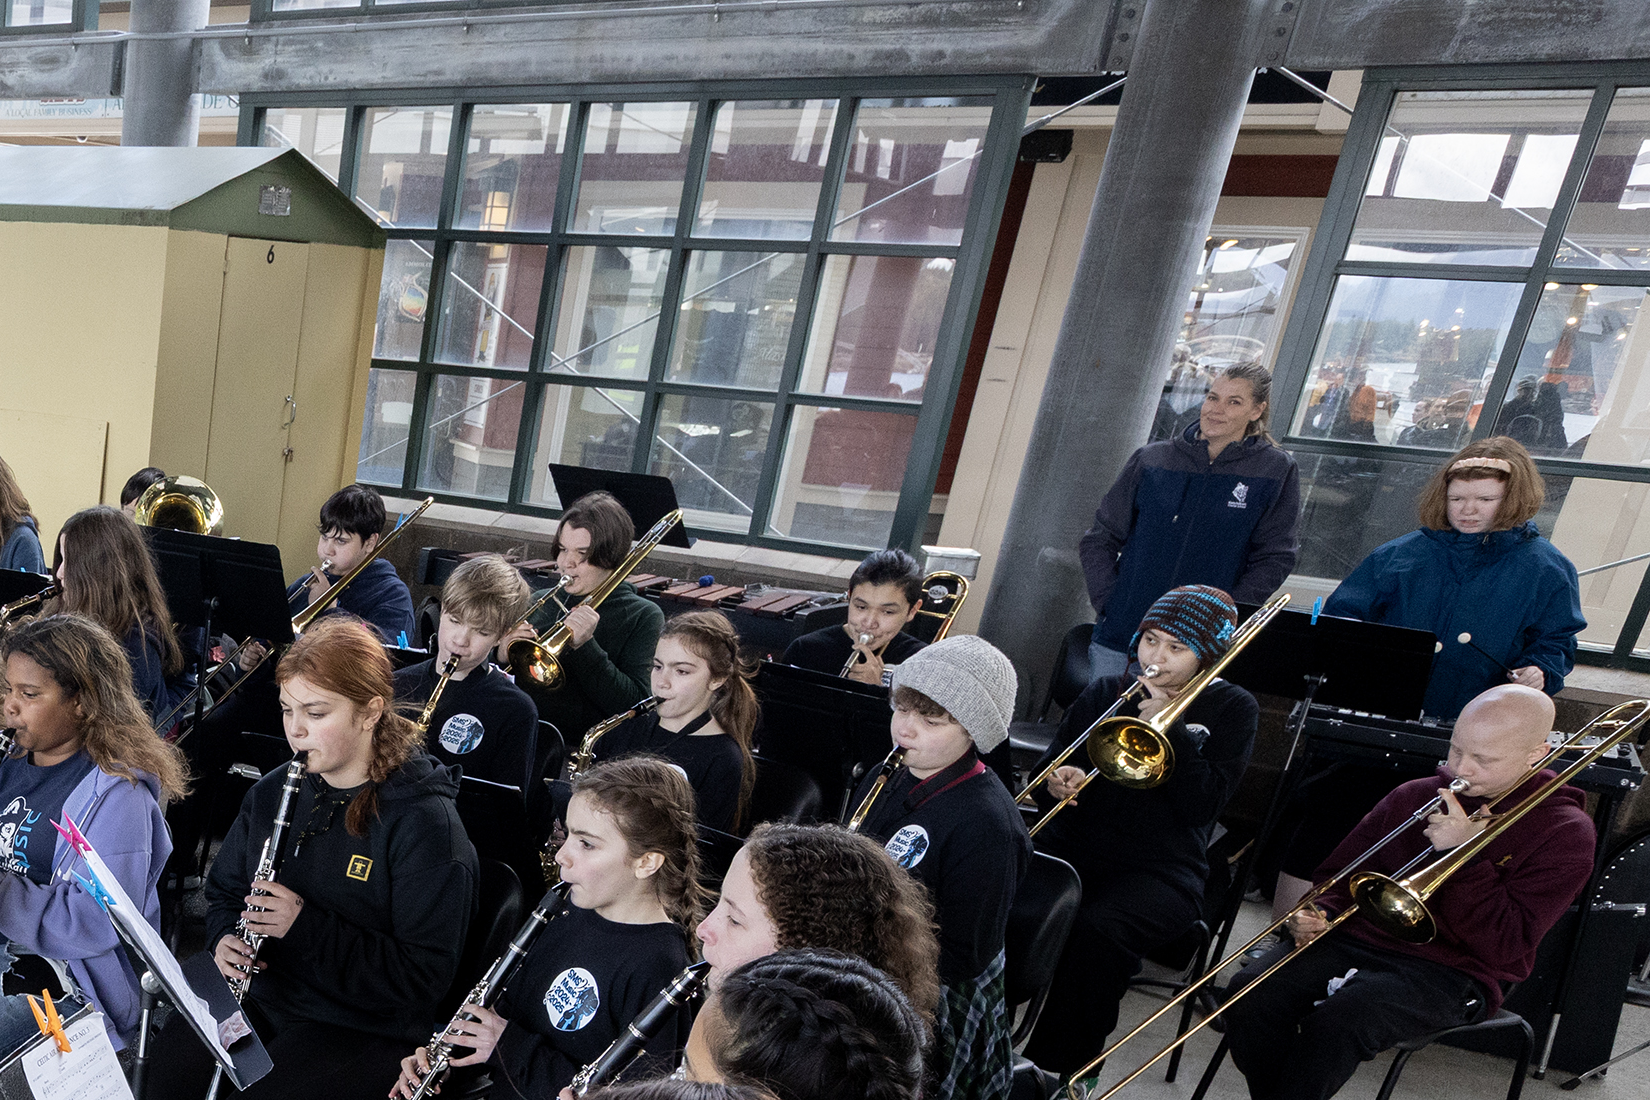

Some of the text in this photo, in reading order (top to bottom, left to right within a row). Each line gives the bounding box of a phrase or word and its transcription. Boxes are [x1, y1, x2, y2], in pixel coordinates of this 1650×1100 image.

[58, 102, 92, 115] BUSINESS
[267, 245, 275, 264] 6
[567, 968, 583, 987] SMS
